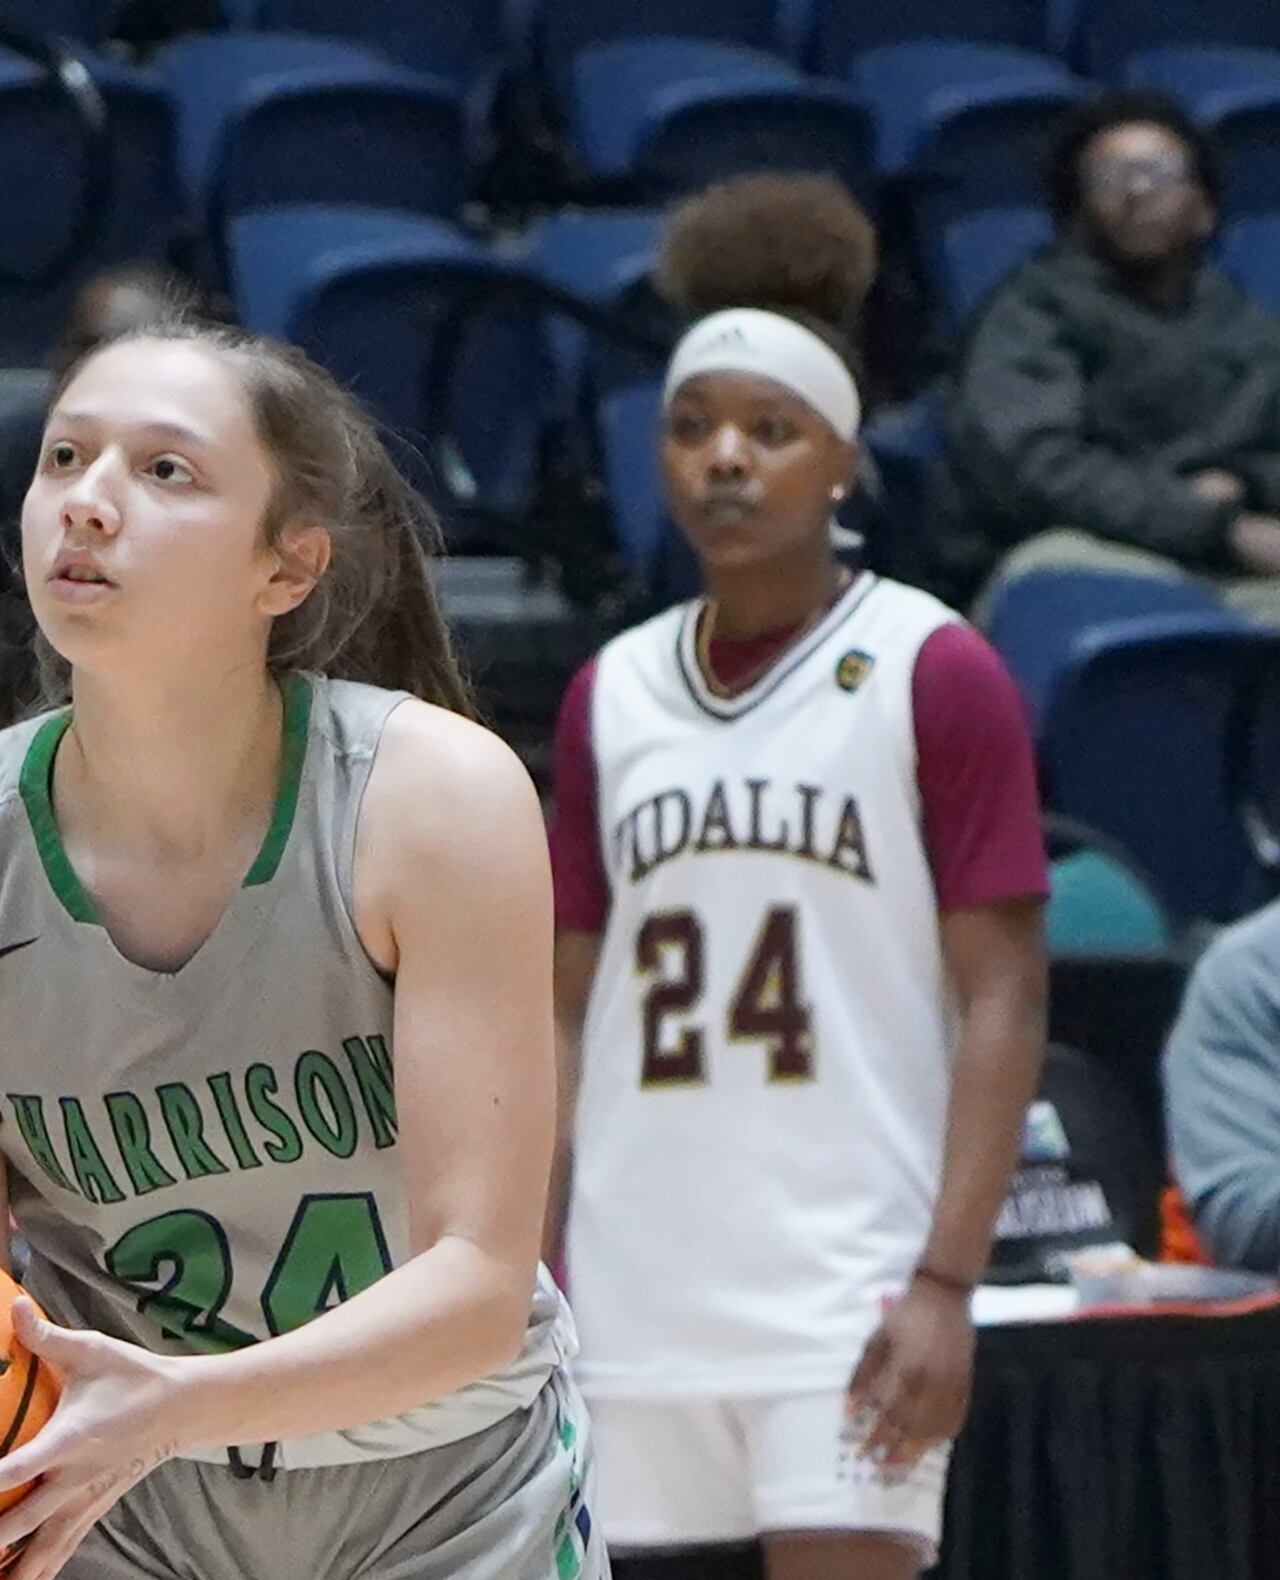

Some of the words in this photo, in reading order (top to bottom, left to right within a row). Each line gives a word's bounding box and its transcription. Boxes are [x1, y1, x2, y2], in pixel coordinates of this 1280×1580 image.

[635, 902, 816, 1090] 24
[6, 1034, 398, 1205] HARRISON
[104, 1192, 394, 1356] 24
